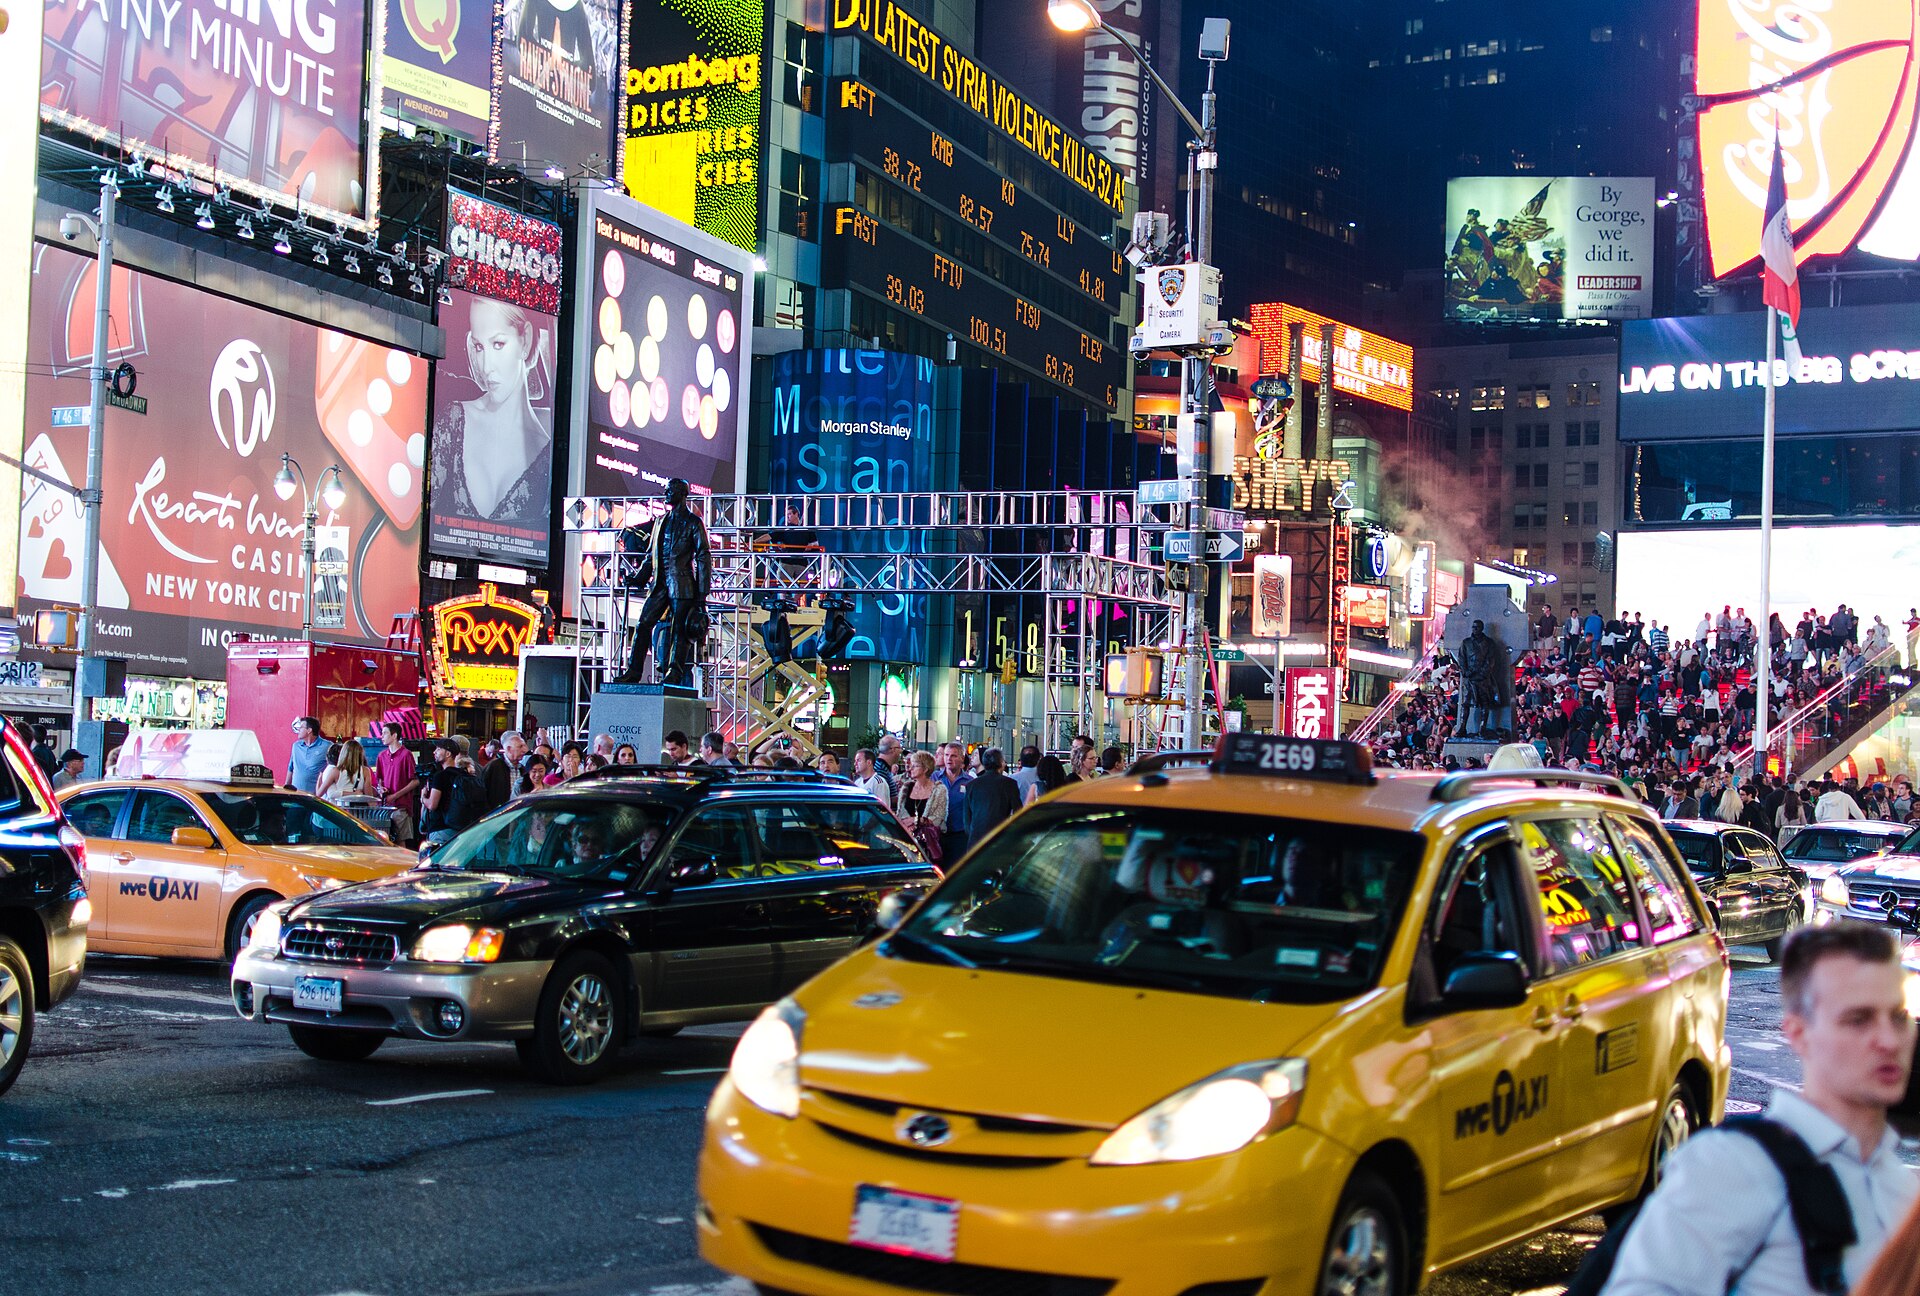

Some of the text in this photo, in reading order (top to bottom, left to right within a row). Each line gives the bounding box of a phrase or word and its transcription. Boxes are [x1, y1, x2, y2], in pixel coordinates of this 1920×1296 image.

[190, 8, 335, 117] MINUTE
[404, 98, 448, 119] AVENUEQ.COM
[841, 80, 876, 117] KFT
[873, 0, 940, 81] LATEST
[942, 44, 988, 118] SYRIA
[992, 79, 1061, 169] VIOLENCE
[1062, 133, 1096, 193] KILLS
[1097, 158, 1112, 204] 52
[1140, 41, 1151, 179] MILK CHOCOLTE
[931, 131, 954, 167] KMB
[883, 146, 922, 193] 38.72
[1600, 186, 1622, 206] By
[835, 207, 879, 247] FAST
[960, 193, 994, 233] 82.57
[1577, 205, 1645, 226] George,
[596, 217, 612, 239] Text
[613, 230, 619, 241] a
[621, 231, 640, 250] word
[641, 238, 650, 254] to
[1057, 214, 1075, 245] LLY
[1598, 229, 1622, 240] we
[450, 225, 559, 284] CHICAGO
[1020, 230, 1050, 269] 75.74
[1585, 245, 1634, 261] did it.
[933, 253, 963, 290] FFIV
[1079, 268, 1105, 302] 41.81
[1579, 278, 1637, 289] LEADERSHIP
[886, 273, 925, 315] 39.03
[1588, 292, 1630, 300] Pass It On.
[1015, 298, 1041, 331] FISV
[1159, 309, 1182, 318] SECURITY
[970, 315, 1007, 355] 100.51
[1080, 333, 1103, 364] FLEX
[1045, 354, 1074, 387] 69.73
[1319, 340, 1329, 428] HERSHEYS
[1363, 355, 1408, 388] PLAZA
[1620, 364, 1675, 393] LIVE
[1680, 361, 1722, 390] ON
[1725, 359, 1789, 388] THS
[1257, 386, 1287, 396] RANCHER
[62, 410, 72, 424] 46
[74, 409, 81, 417] ST
[821, 419, 911, 440] Morgan Stanley
[1142, 482, 1176, 501] W 46 ST
[128, 456, 242, 563] Resorts
[246, 493, 334, 538] Wor
[1205, 540, 1222, 552] AY
[320, 563, 343, 573] SPY
[1172, 570, 1184, 582] ONE
[146, 572, 197, 600] NEW
[206, 580, 261, 608] YORK
[202, 627, 217, 647] IN
[1215, 651, 1236, 659] 47 St
[100, 690, 174, 717] GRAND
[1296, 674, 1329, 739] tkts
[608, 725, 642, 734] GEORGE
[243, 764, 261, 777] 8E39
[1260, 743, 1316, 772] 2E69
[120, 875, 199, 901] NYC TAXI
[1455, 1068, 1549, 1140] NYC TAXI
